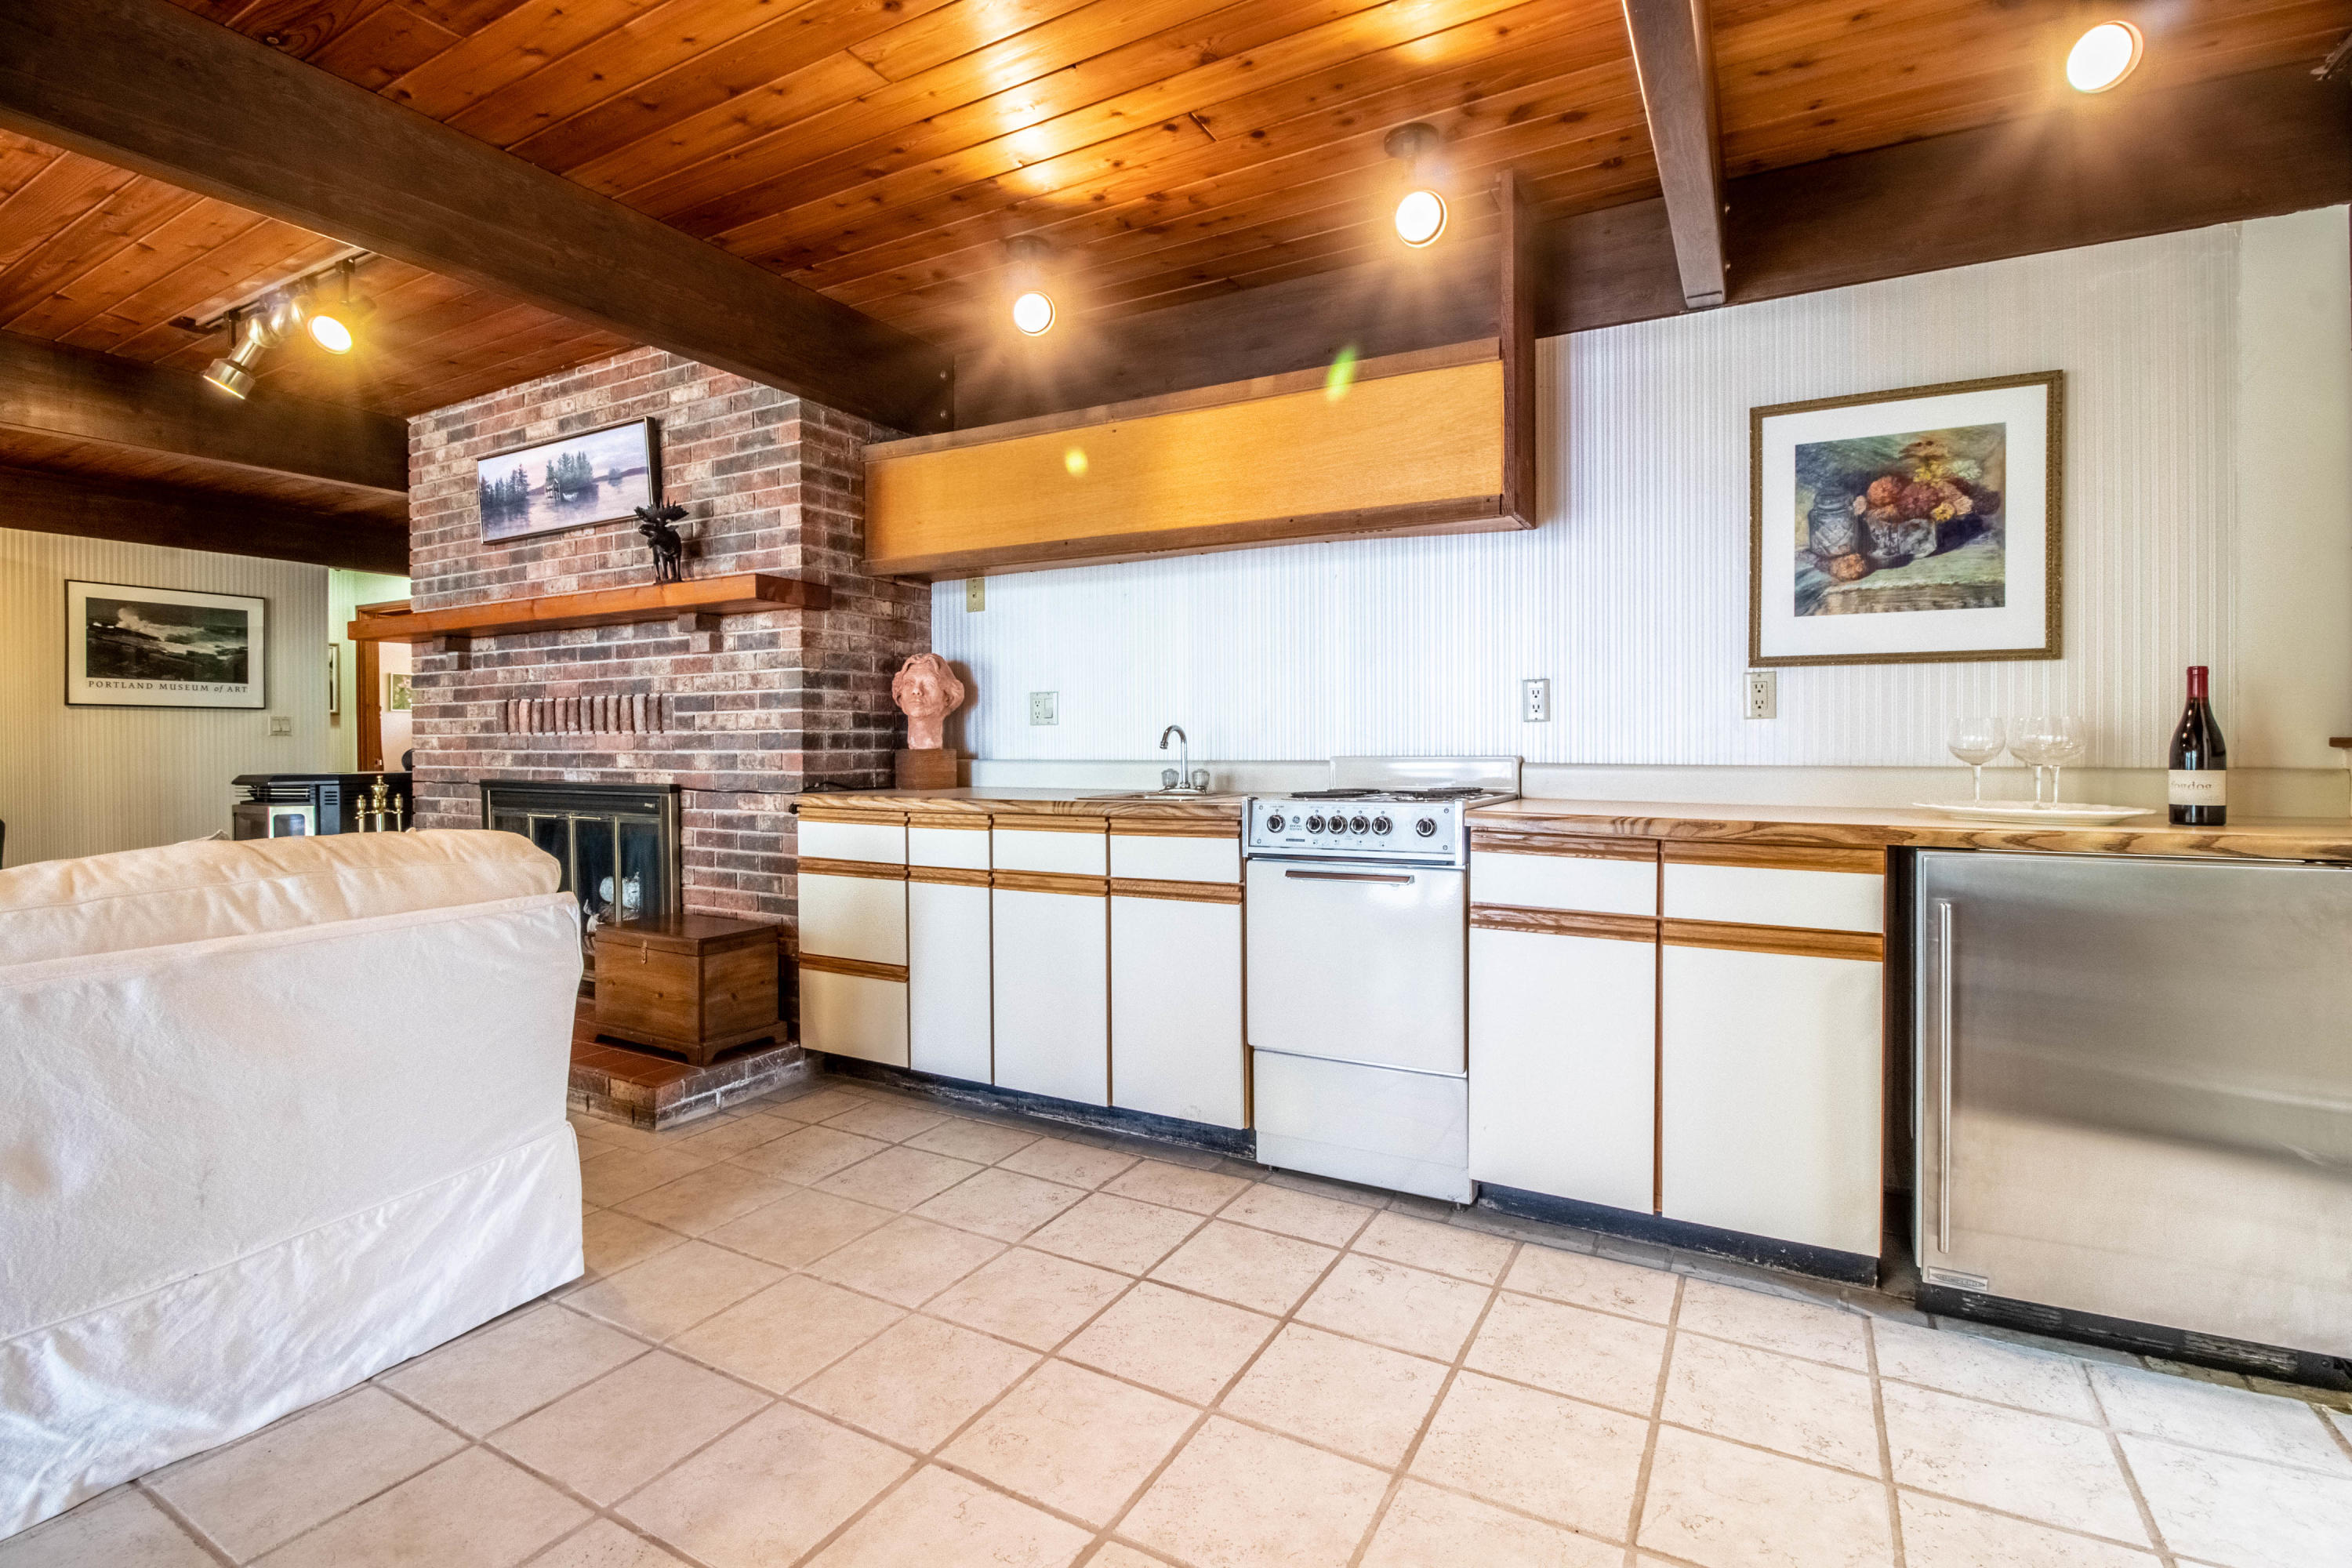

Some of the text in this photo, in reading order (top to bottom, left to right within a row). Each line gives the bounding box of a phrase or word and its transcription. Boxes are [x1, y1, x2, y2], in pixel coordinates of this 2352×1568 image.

[89, 681, 153, 689] PORTLAND
[159, 683, 209, 691] MUSEUM
[213, 684, 224, 693] of
